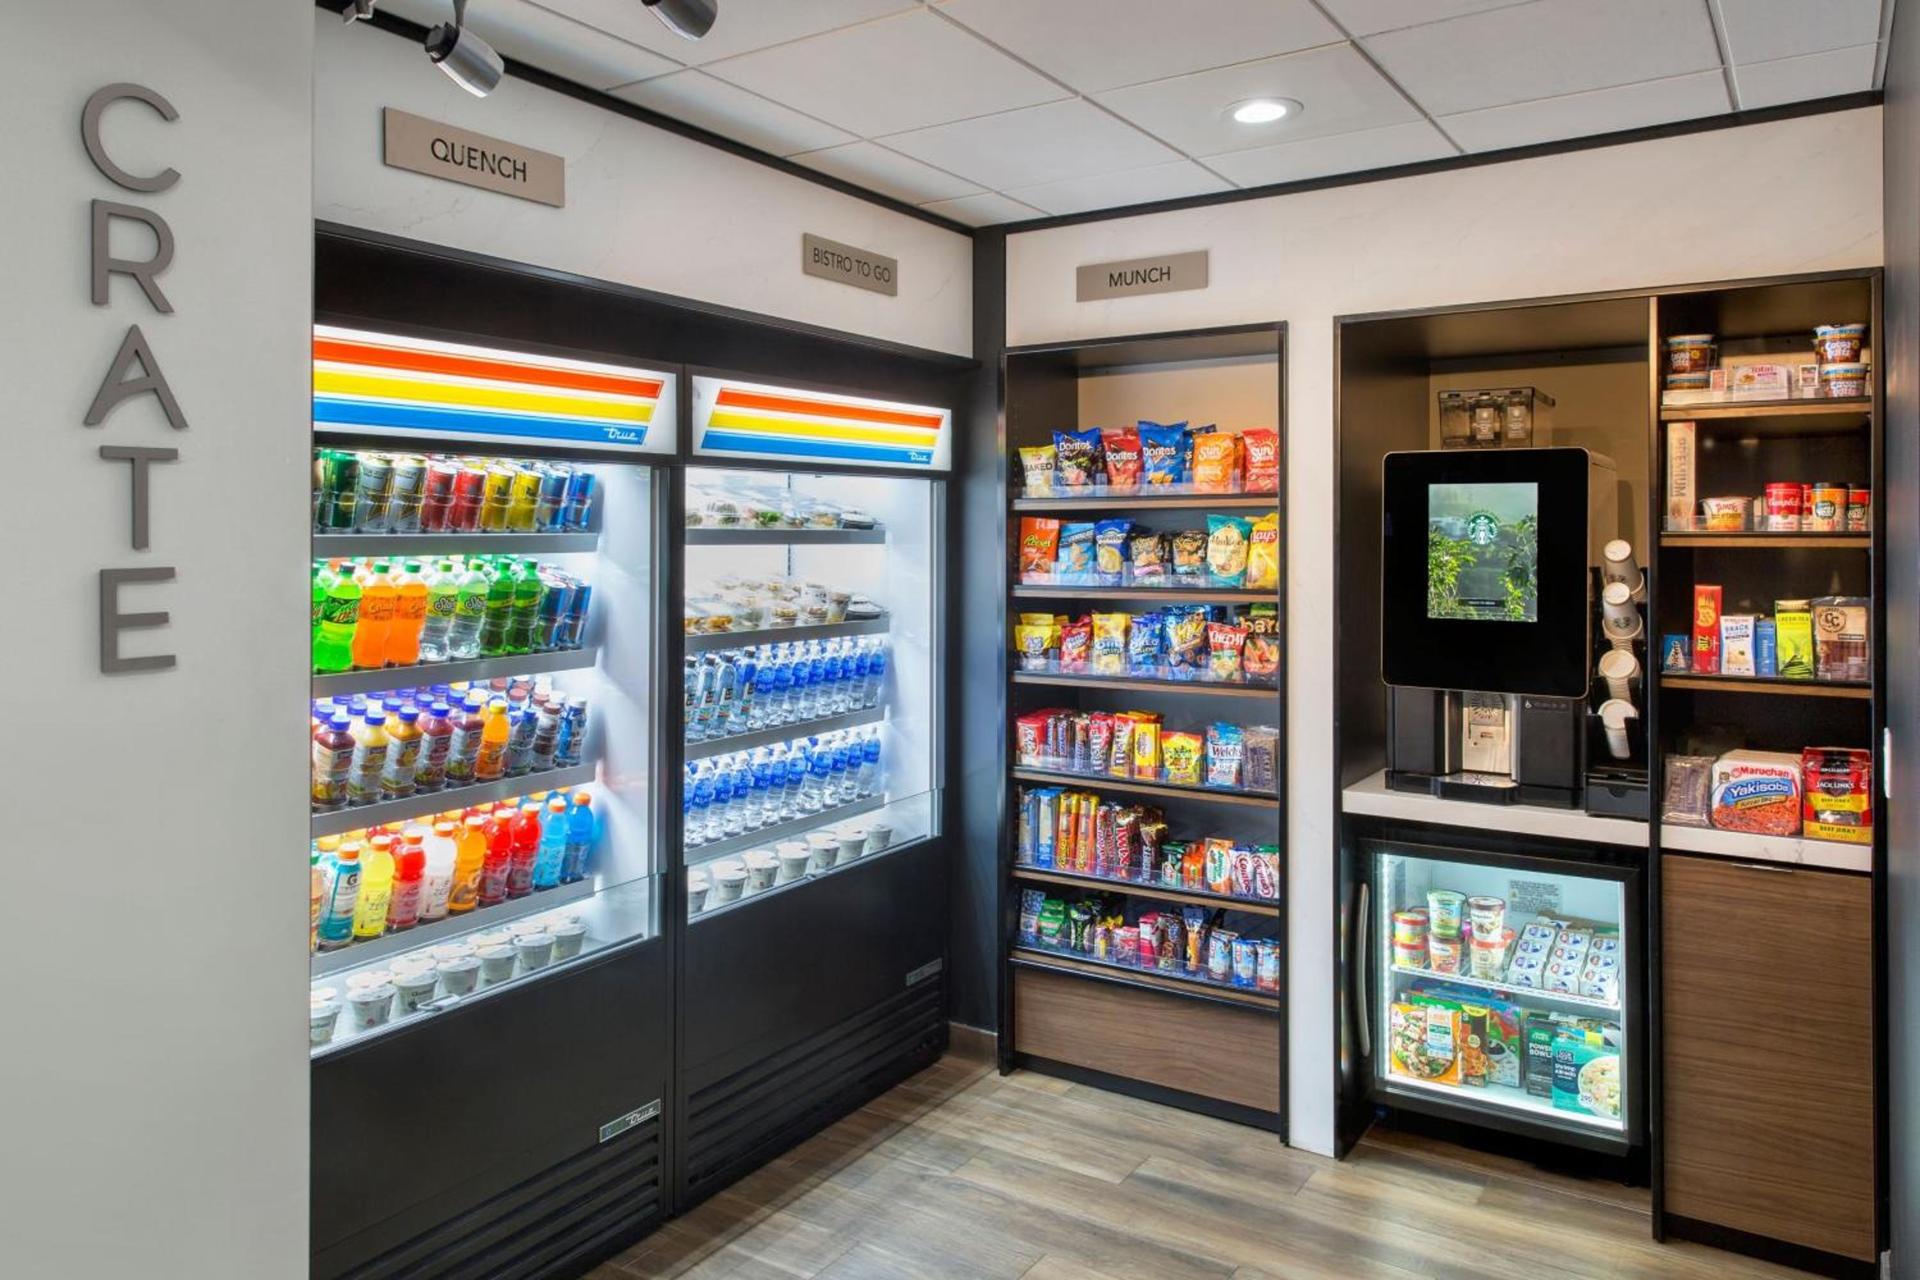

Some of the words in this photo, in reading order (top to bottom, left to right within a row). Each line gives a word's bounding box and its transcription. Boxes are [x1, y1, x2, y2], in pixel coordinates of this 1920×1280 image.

[430, 137, 528, 183] QUENCH
[813, 247, 853, 273] BISTRO
[855, 259, 871, 278] TO
[873, 265, 891, 283] GO
[1108, 265, 1171, 288] MUNCH
[81, 82, 189, 676] CRATE
[602, 427, 639, 441] True
[1059, 441, 1093, 452] Doritos
[1143, 446, 1177, 457] Doritos
[1106, 451, 1138, 462] Doritos
[1740, 766, 1789, 777] Maruchan
[1730, 780, 1789, 798] Yakisoba
[346, 873, 358, 886] G
